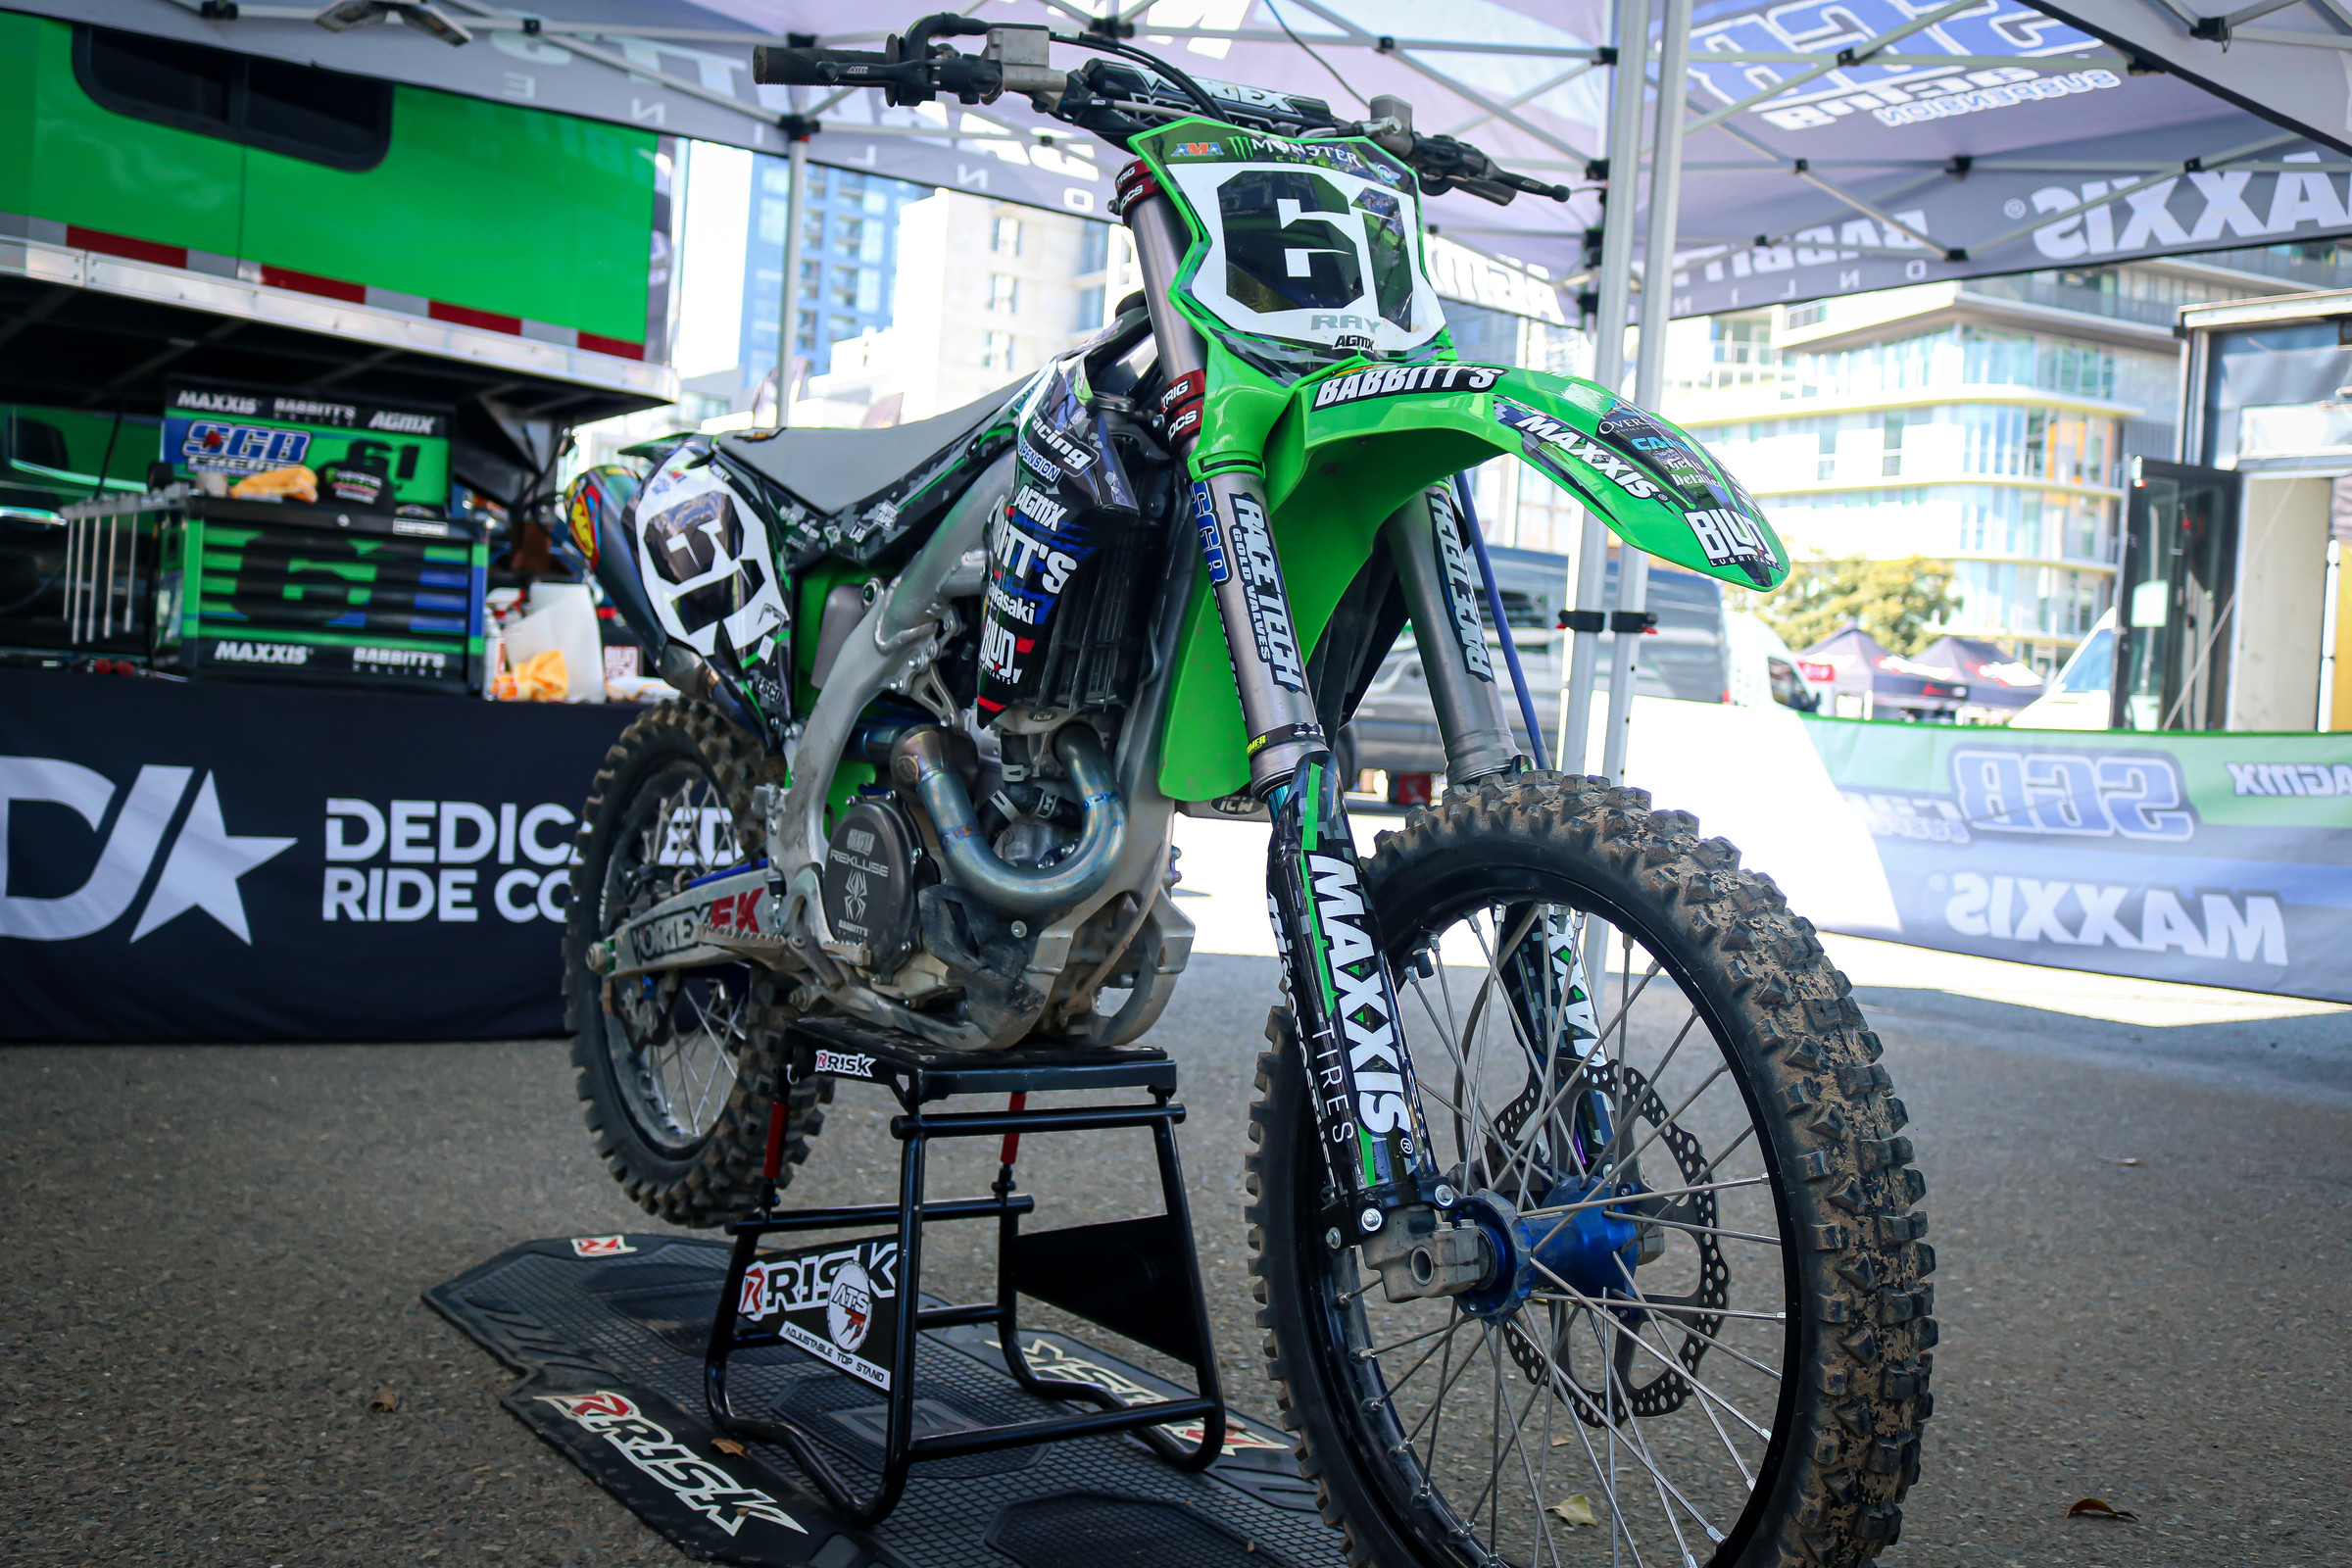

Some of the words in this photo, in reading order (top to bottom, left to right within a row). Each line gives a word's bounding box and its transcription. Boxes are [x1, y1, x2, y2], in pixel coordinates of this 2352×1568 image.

[1171, 142, 1224, 157] AMA
[1250, 138, 1363, 169] MONSTER
[1216, 171, 1413, 333] 61
[1310, 315, 1381, 334] RAY
[1332, 335, 1375, 351] AGMX
[177, 390, 257, 415] MAXXIS
[1314, 366, 1504, 408] BABBITT'S
[368, 412, 436, 434] AGMX
[1515, 416, 1661, 500] MAXXIS
[1013, 485, 1068, 532] AGMX
[1246, 584, 1272, 661] VALVES
[215, 640, 309, 665] MAXXIS
[830, 849, 889, 878] REKLUSE
[322, 868, 478, 922] RIDE
[1308, 854, 1412, 1134] MAXXIS
[1312, 1021, 1355, 1145] TIRES
[785, 1326, 833, 1357] ADJUSTABLE
[837, 1352, 854, 1366] TOP
[856, 1362, 885, 1383] STAND
